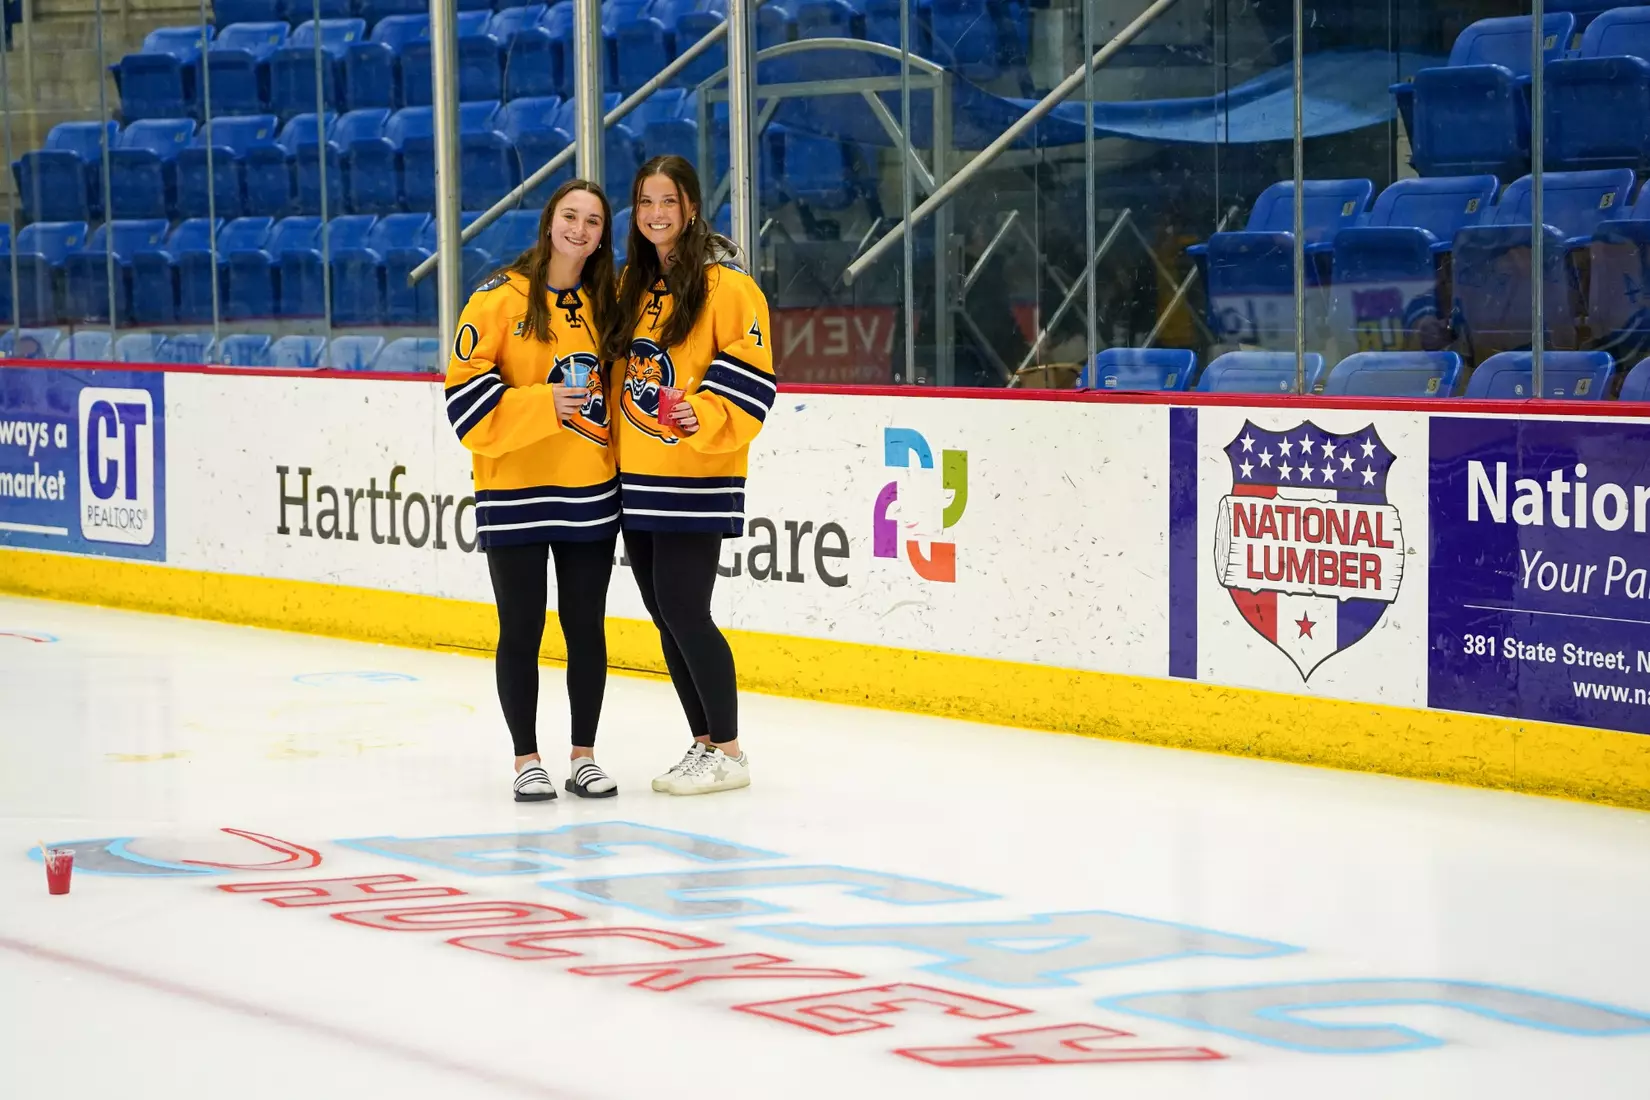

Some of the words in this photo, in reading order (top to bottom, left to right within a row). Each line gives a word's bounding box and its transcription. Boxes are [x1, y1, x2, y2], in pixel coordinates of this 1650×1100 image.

[748, 316, 765, 348] 4
[54, 423, 68, 449] a
[87, 400, 147, 501] CT
[0, 461, 66, 501] market
[1233, 502, 1395, 549] NATIONAL
[1246, 544, 1382, 591] LUMBER
[1520, 549, 1598, 594] Your
[1604, 555, 1650, 600] Pa
[1463, 634, 1496, 657] 381
[1503, 637, 1556, 664] State
[1562, 642, 1631, 674] Street,
[1573, 681, 1650, 706] www.n
[217, 874, 1230, 1068] HOCKEY
